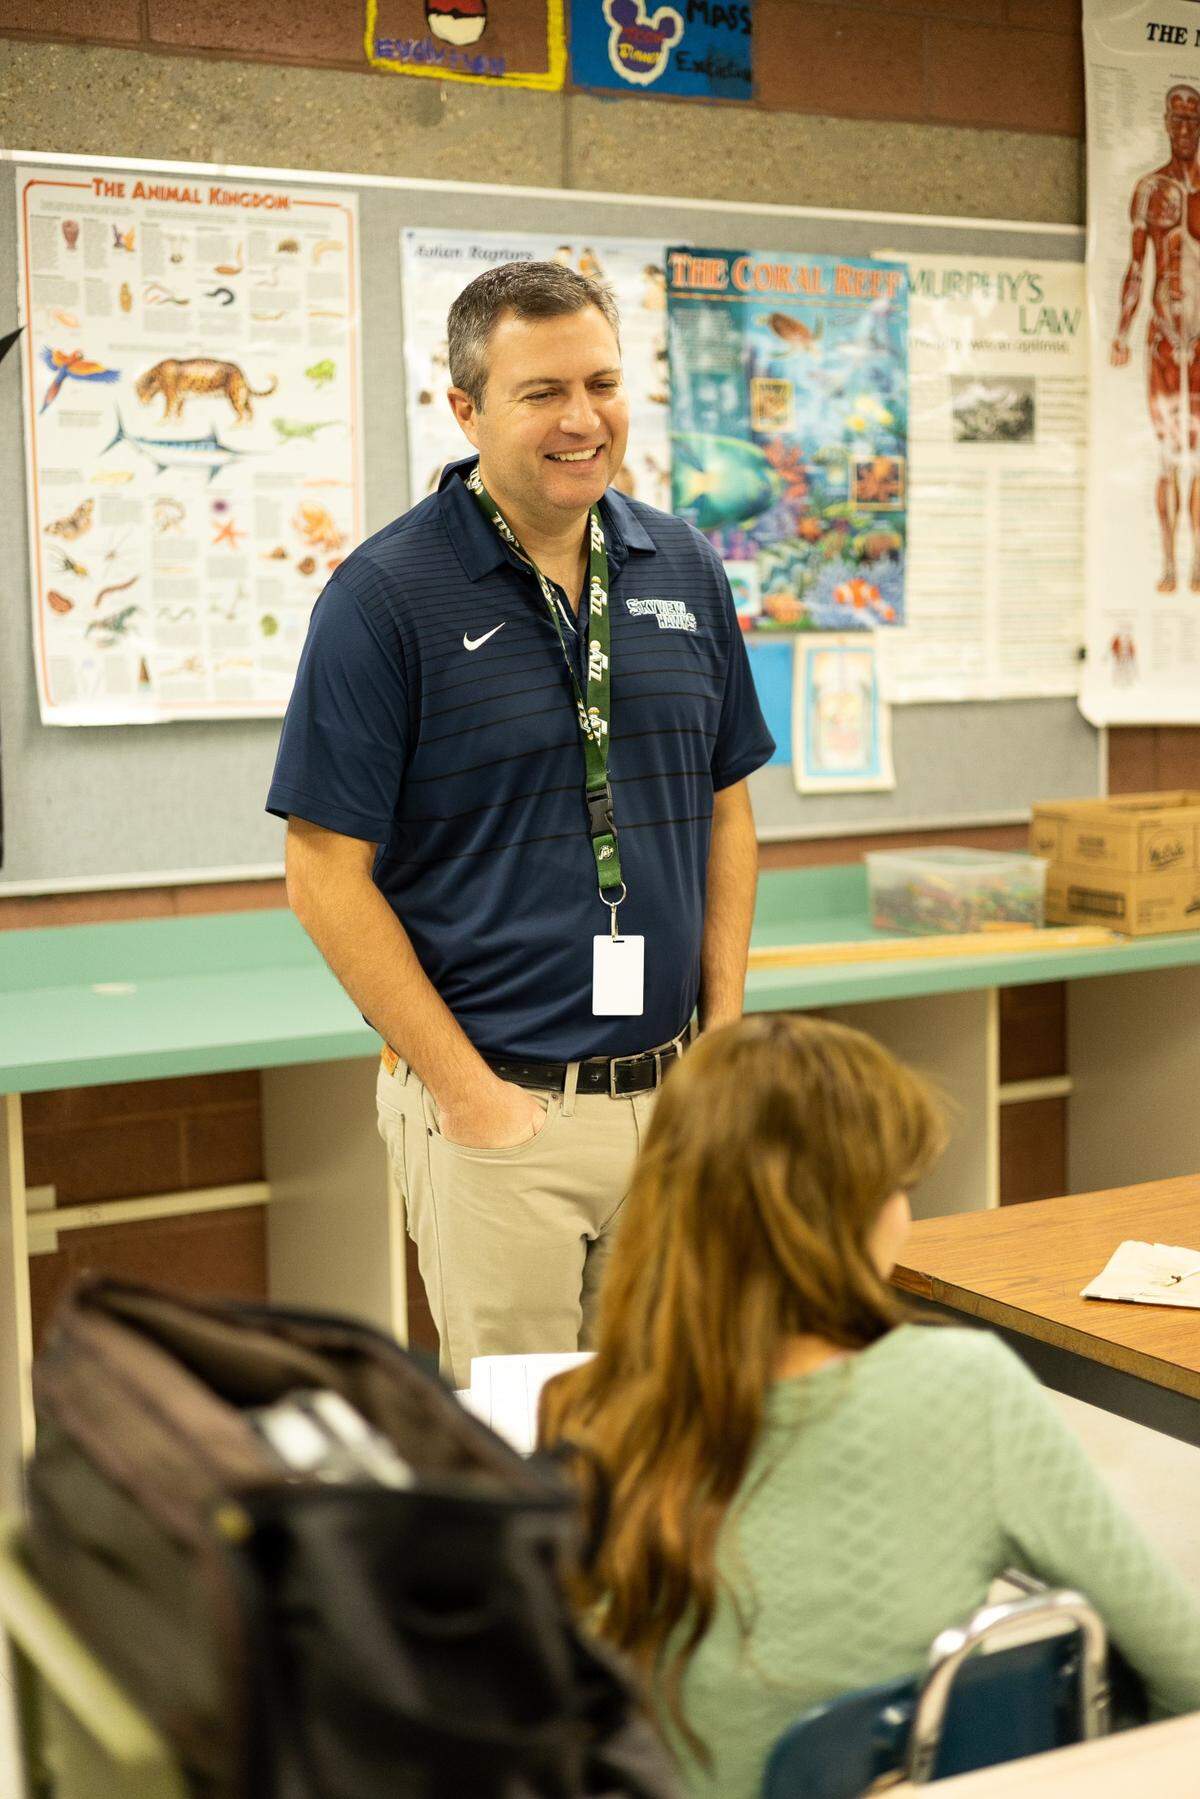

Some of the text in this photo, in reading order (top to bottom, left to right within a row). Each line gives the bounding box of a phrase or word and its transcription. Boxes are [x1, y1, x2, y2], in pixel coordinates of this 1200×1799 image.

[686, 0, 752, 35] MASS
[1146, 22, 1188, 45] THE
[93, 177, 290, 209] THE ANIMAL KINGDOM
[669, 252, 903, 298] THE CORAL REEF
[908, 269, 1044, 304] MURPHY'S
[1018, 305, 1081, 336] LAW
[656, 612, 697, 632] HAWKS
